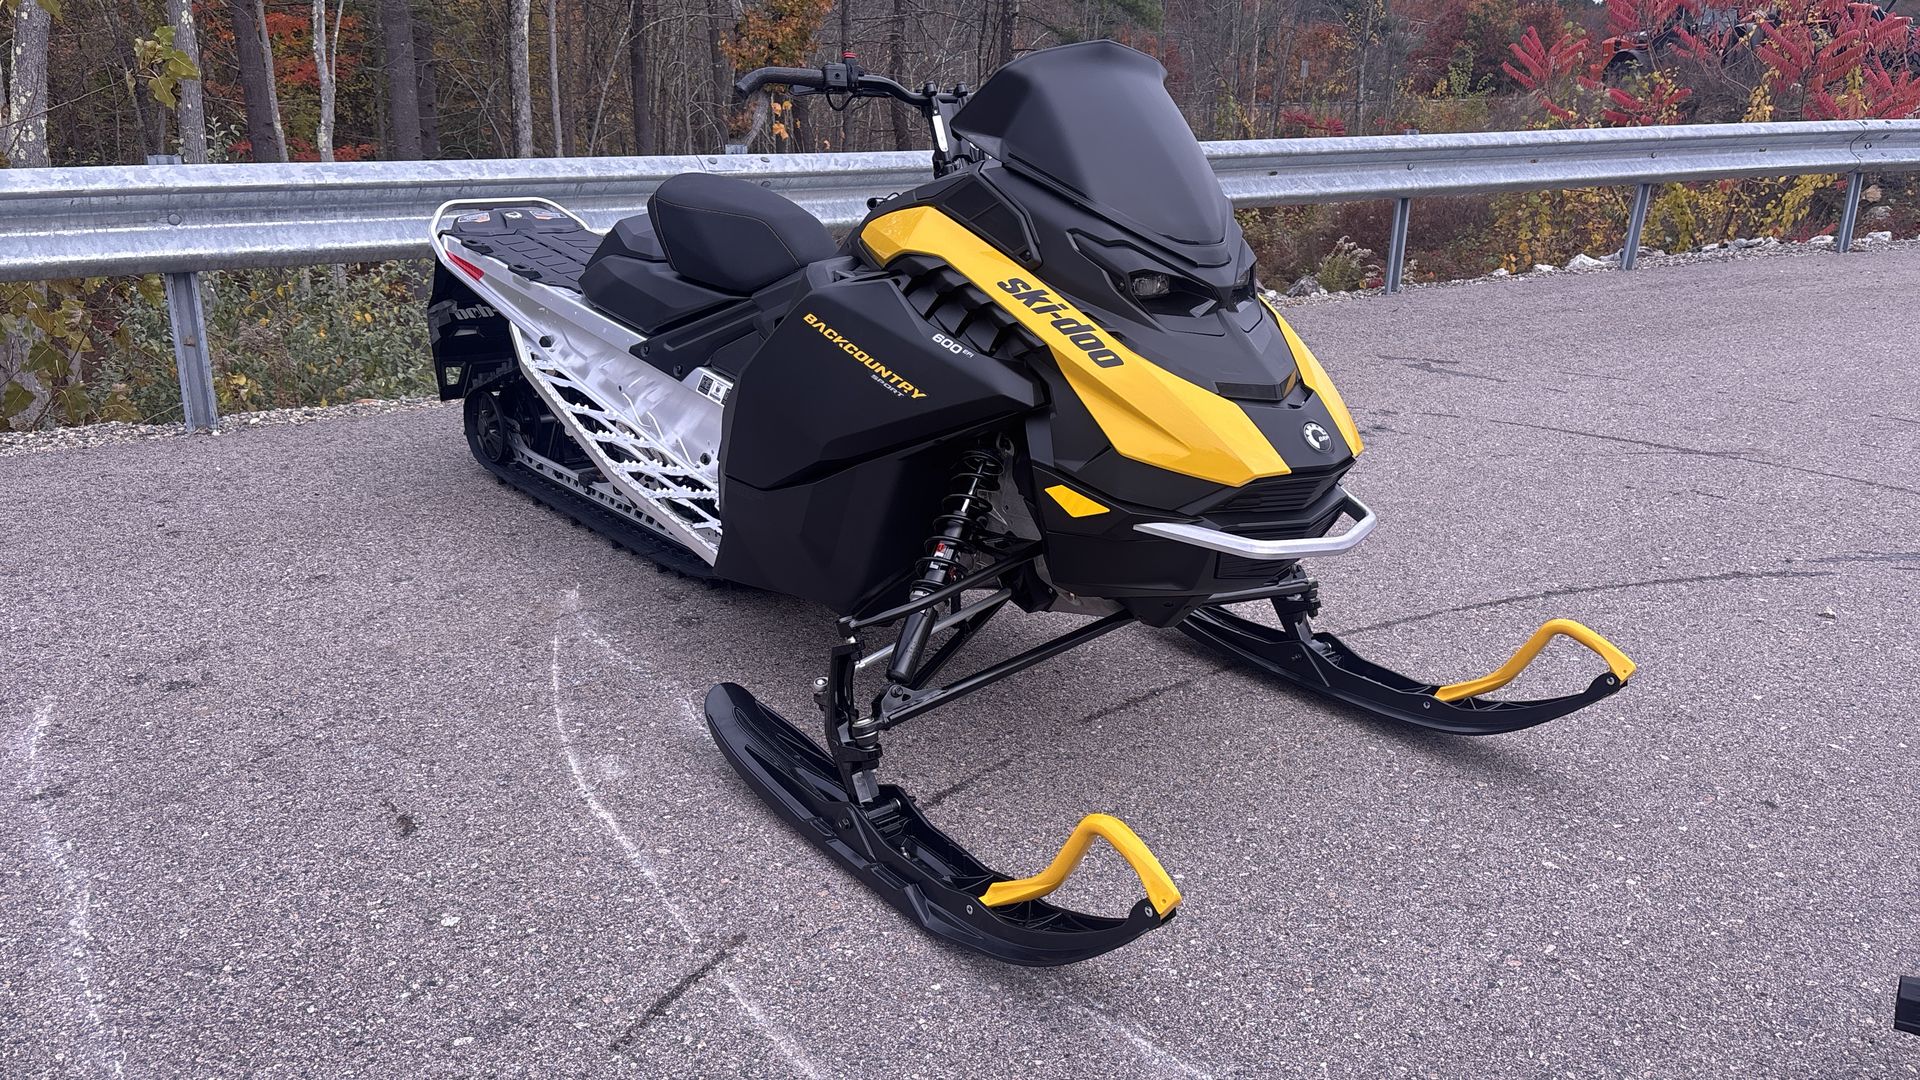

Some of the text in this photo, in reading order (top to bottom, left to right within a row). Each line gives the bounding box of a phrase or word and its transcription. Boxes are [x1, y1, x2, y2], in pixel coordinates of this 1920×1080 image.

[932, 333, 974, 358] 600 EFI
[997, 278, 1124, 368] ski-doo
[803, 313, 928, 400] BACKCOUNTRY
[871, 374, 904, 397] SPORT
